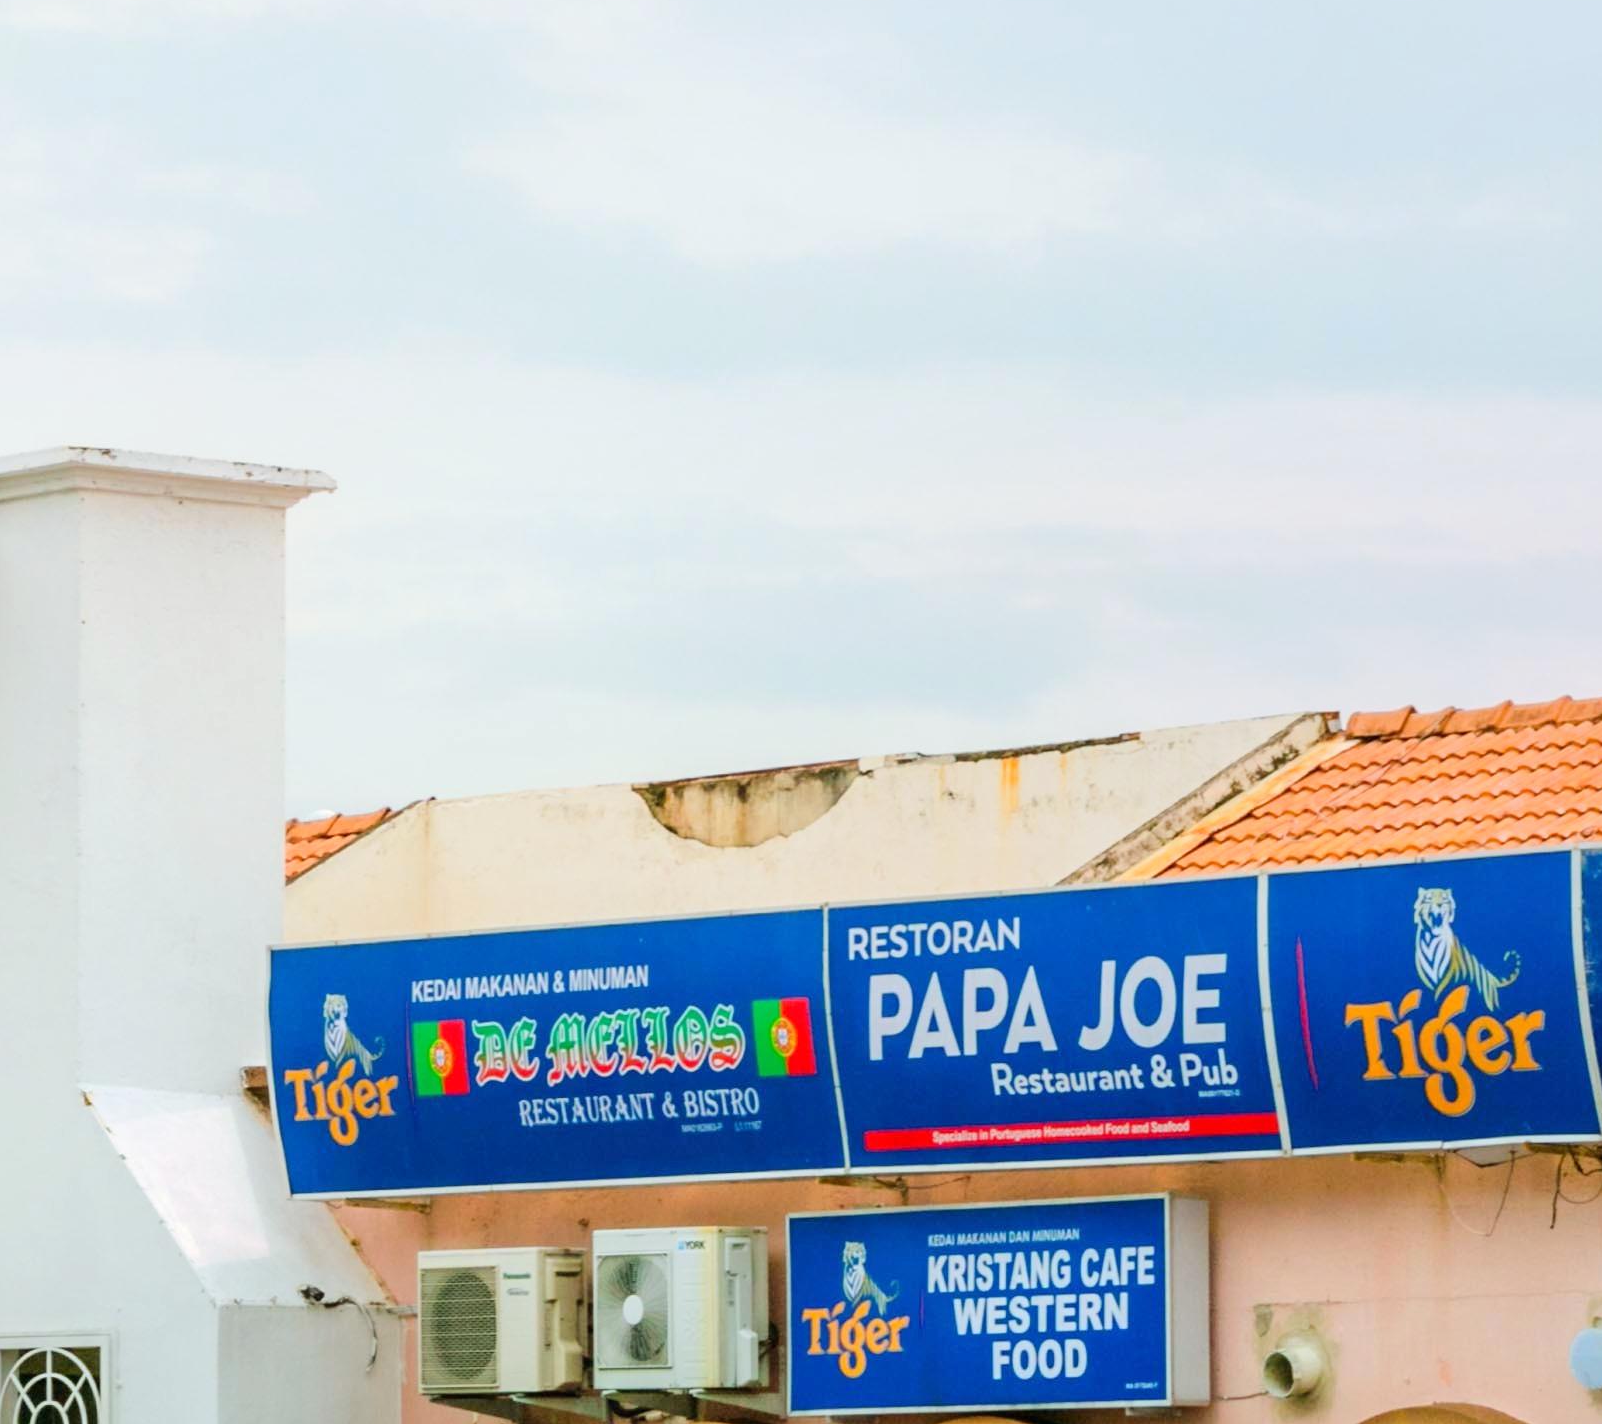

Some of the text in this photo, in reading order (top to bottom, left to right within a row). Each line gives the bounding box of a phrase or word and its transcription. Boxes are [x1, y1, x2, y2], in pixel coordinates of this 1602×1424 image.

[848, 917, 1021, 961] RESTORAN
[411, 965, 649, 1003] KEDAI MAKANAN & MINUMAN
[868, 953, 1228, 1061] PAPA JOE
[472, 1004, 747, 1087] DE MELLOS
[1344, 985, 1546, 1117] Tiger
[990, 1048, 1238, 1096] Restaurant & Pub
[284, 1059, 399, 1146] Tiger
[518, 1087, 760, 1127] RESTAURANT & BISTRO
[928, 1228, 1080, 1246] KEDAI MAKANAN DAN MINUMAN
[928, 1246, 1155, 1293] KRISTANG CAFE
[954, 1292, 1129, 1335] WESTERN
[802, 1300, 910, 1378] Tiger
[992, 1339, 1088, 1380] FOOD
